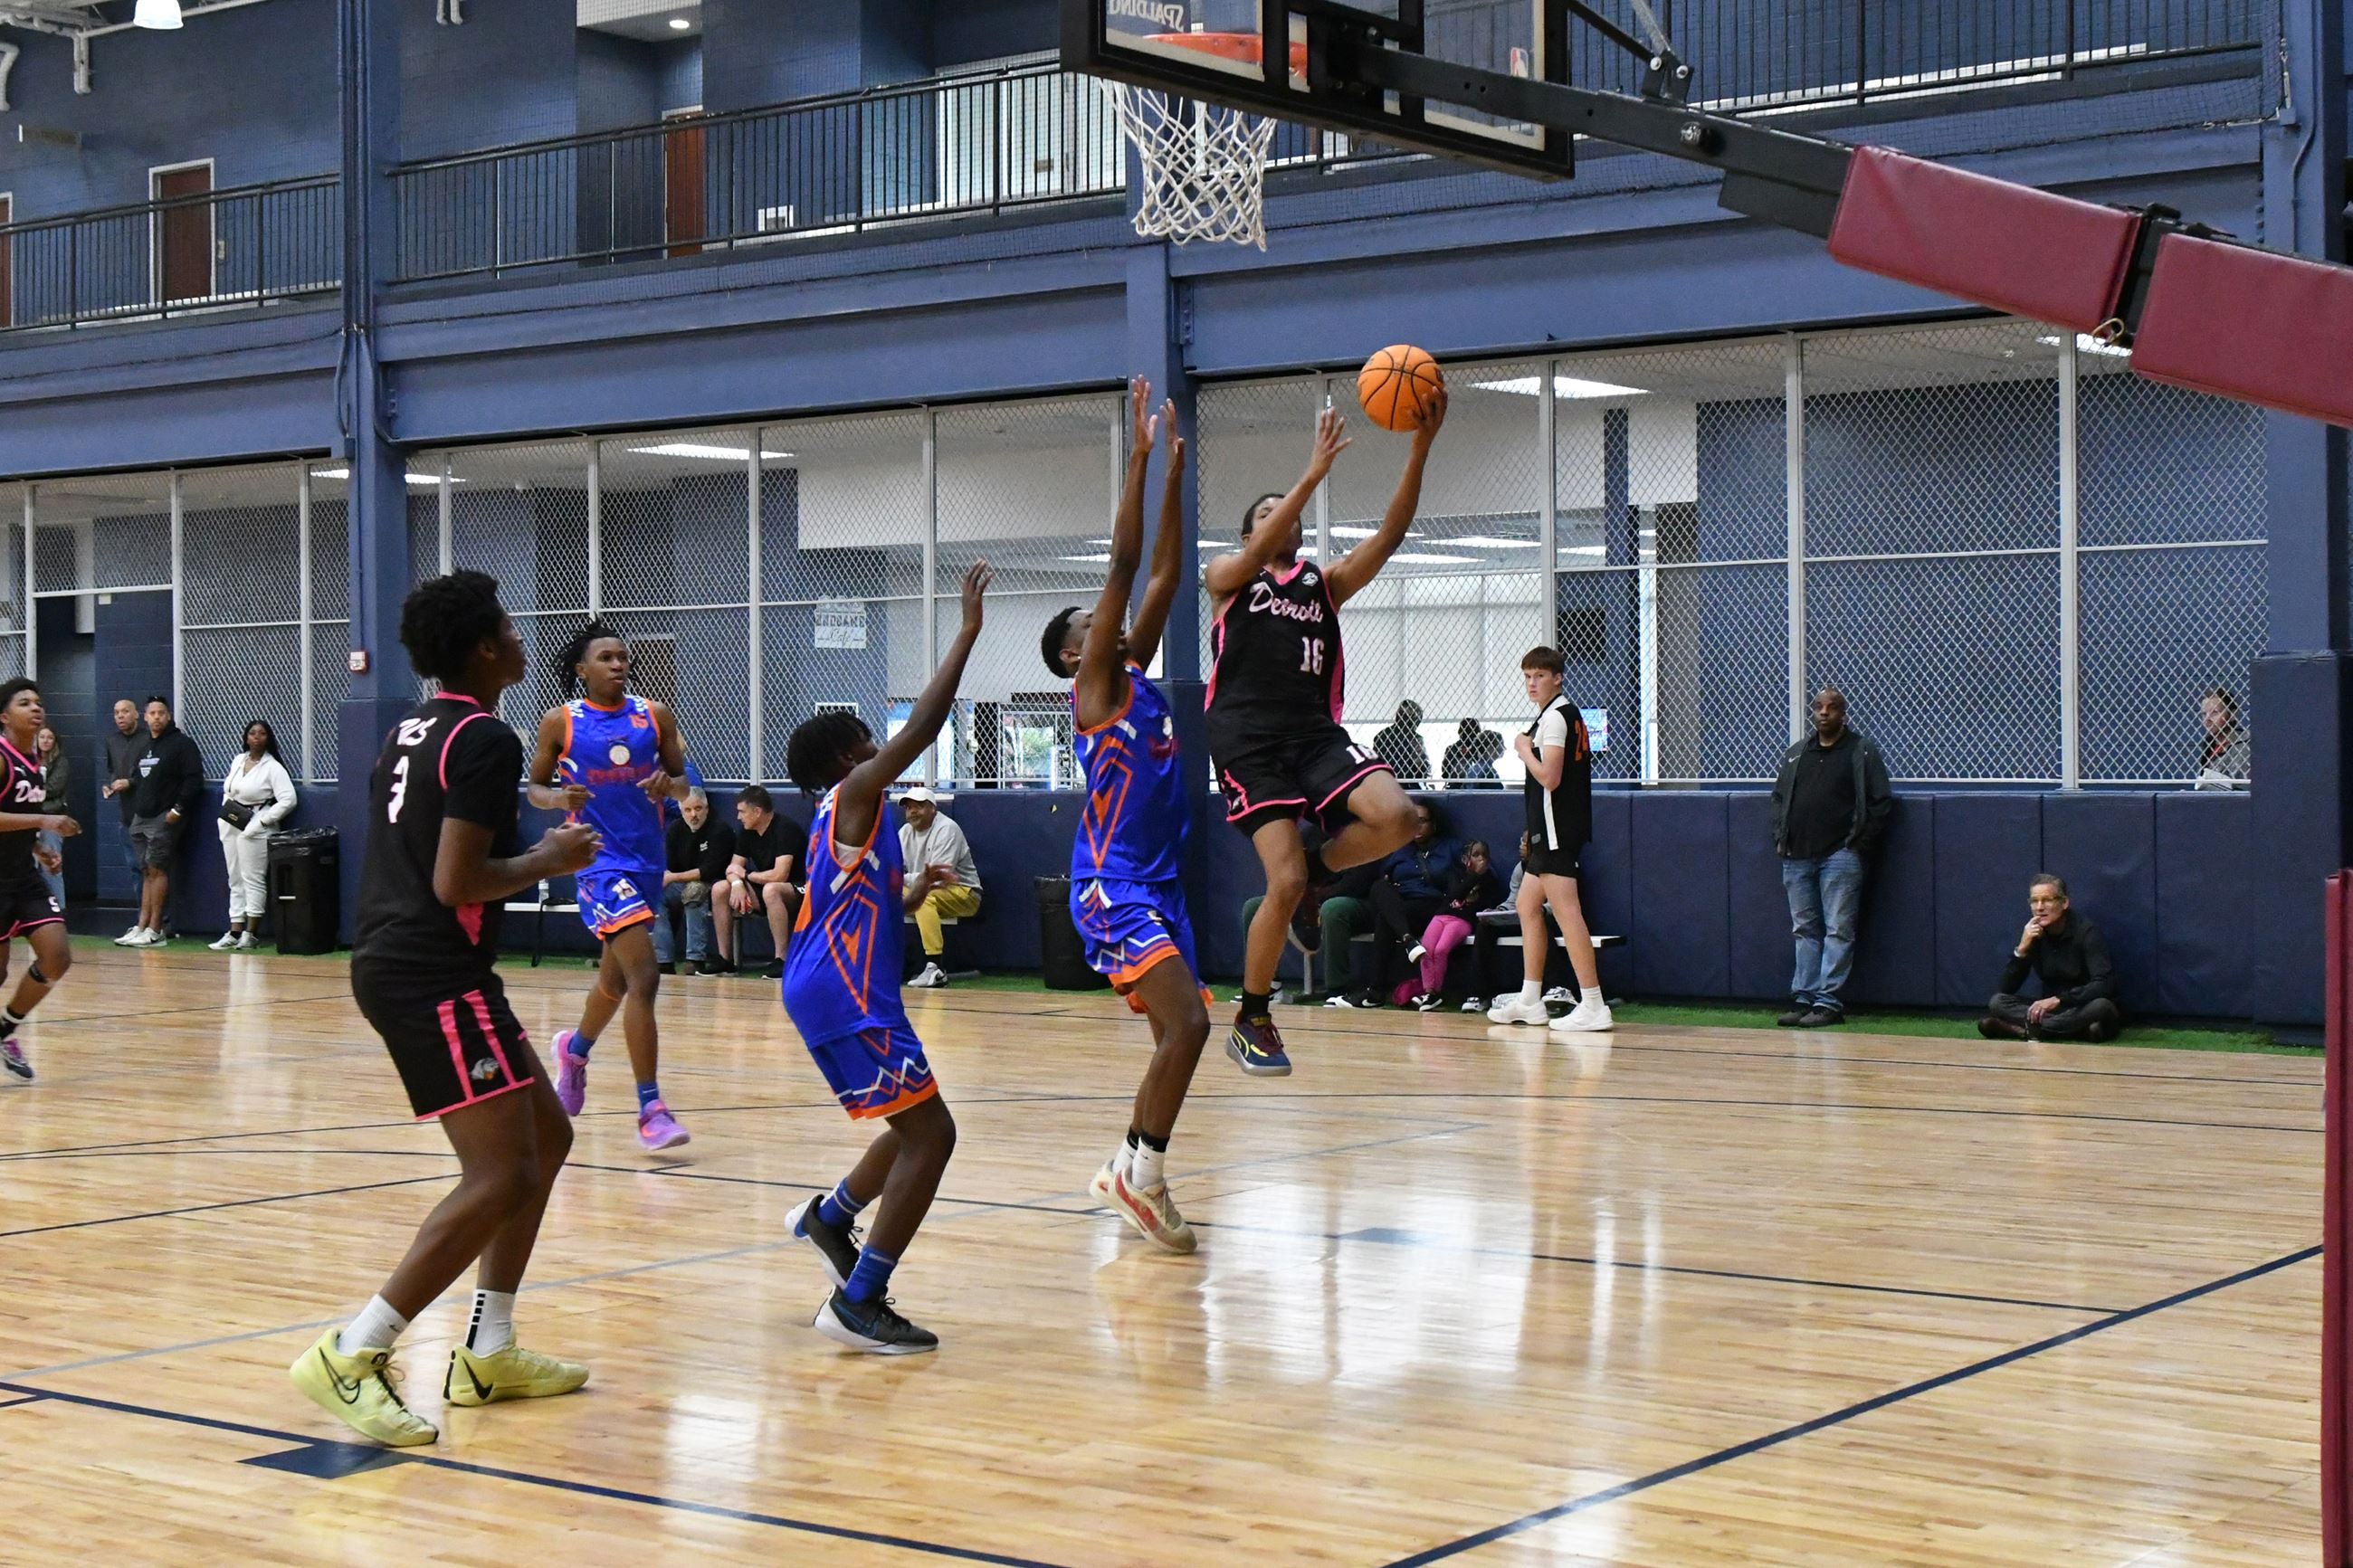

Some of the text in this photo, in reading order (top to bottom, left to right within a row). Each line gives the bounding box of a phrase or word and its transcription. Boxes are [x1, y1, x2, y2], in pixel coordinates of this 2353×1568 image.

[1249, 581, 1323, 622] Detroit
[1300, 636, 1324, 675] 16
[612, 878, 638, 901] 15
